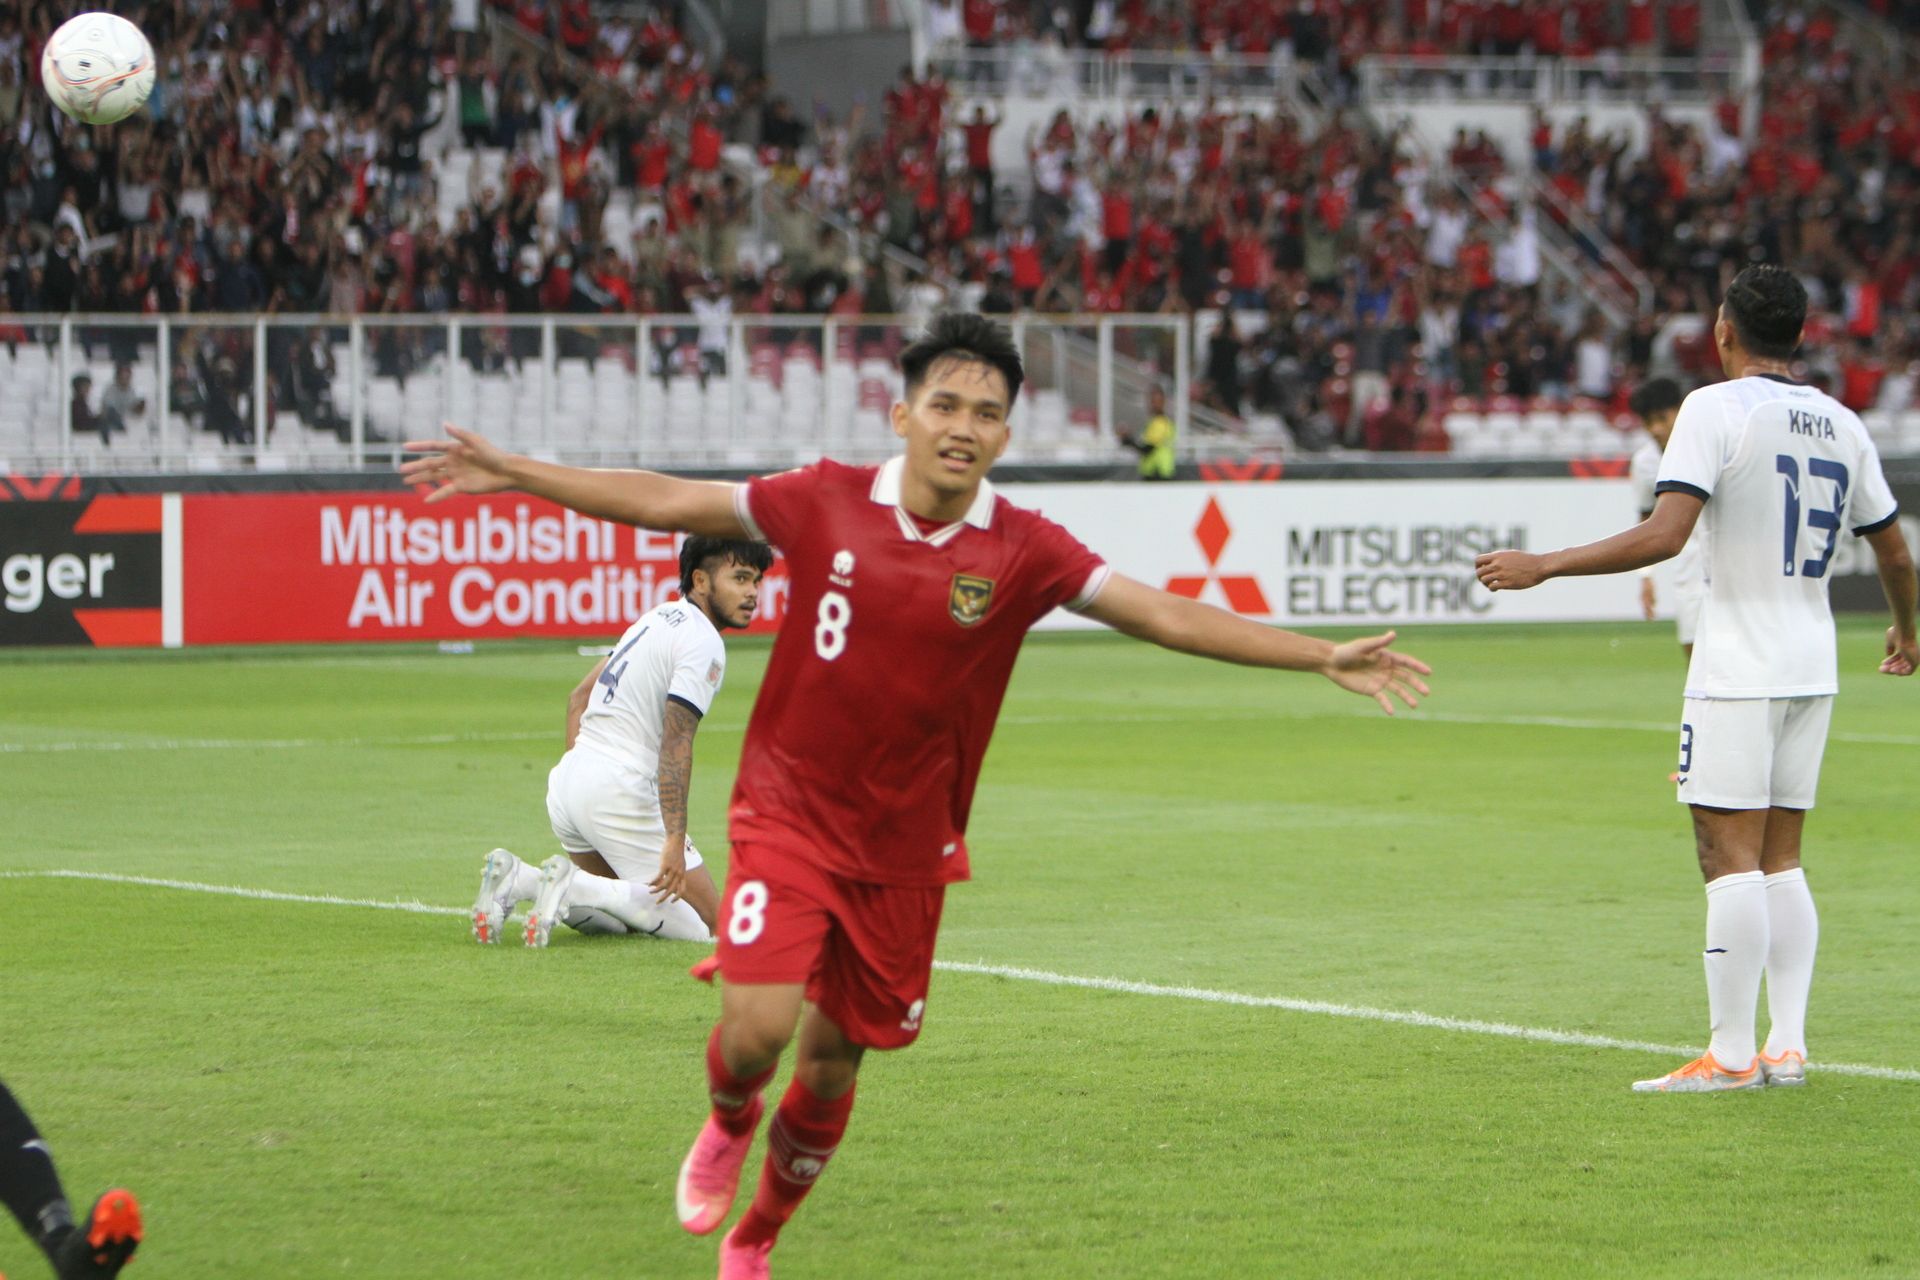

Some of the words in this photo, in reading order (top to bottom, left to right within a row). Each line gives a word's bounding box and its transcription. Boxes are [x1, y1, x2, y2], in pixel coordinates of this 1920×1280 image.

[1788, 408, 1836, 441] KRYA
[320, 504, 615, 566] Mitsubishi
[1287, 525, 1527, 568] MITSUBISHI
[1776, 454, 1849, 579] 13
[1, 552, 115, 614] ger
[347, 567, 435, 628] Air
[1287, 574, 1495, 616] ELECTRIC
[815, 591, 852, 661] 8
[598, 625, 649, 704] 4
[728, 880, 769, 945] 8
